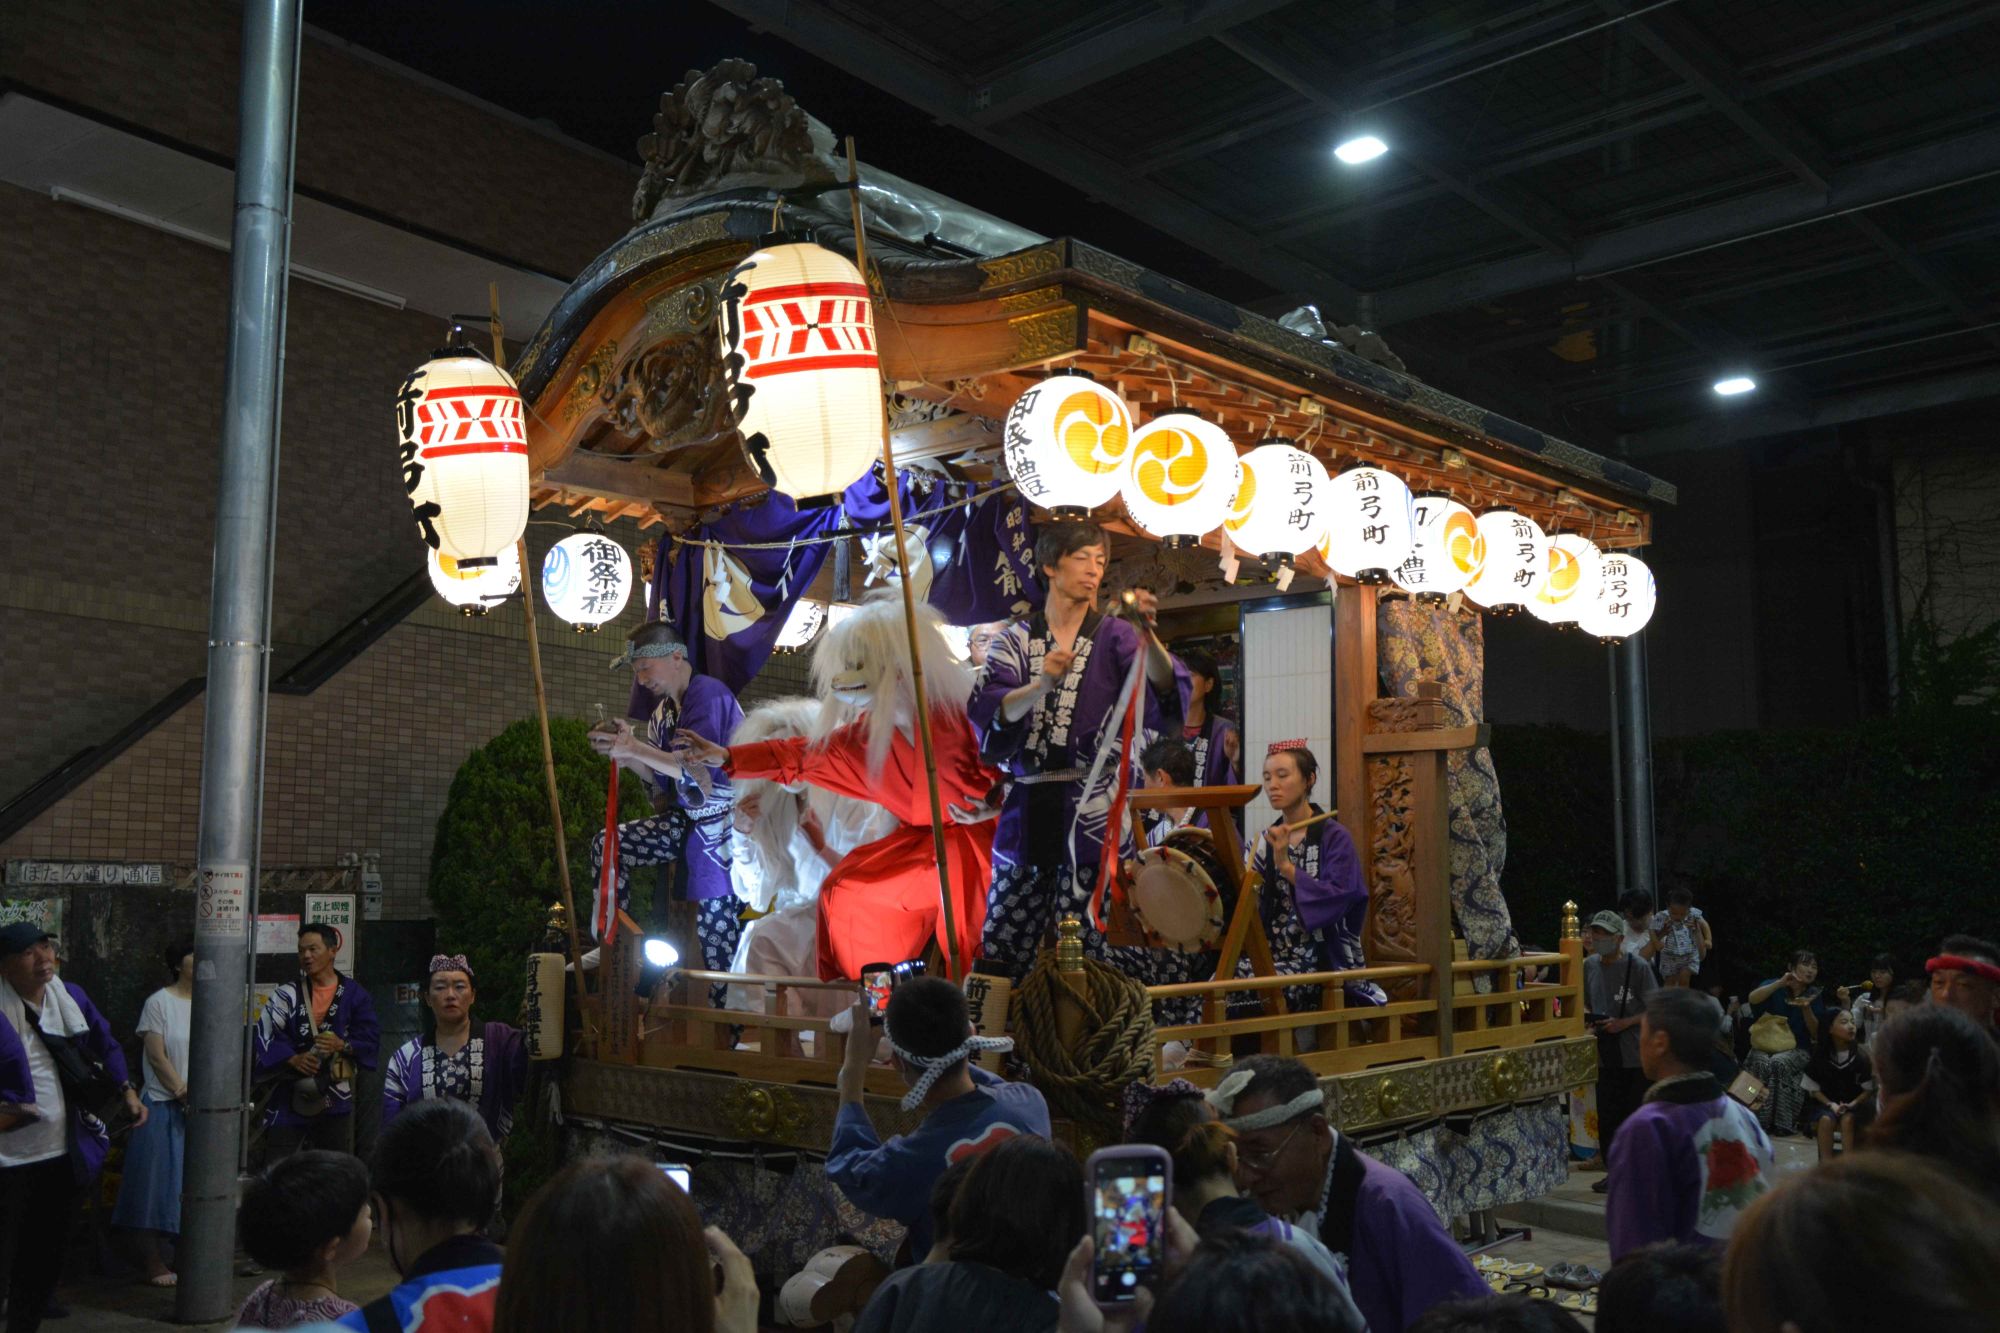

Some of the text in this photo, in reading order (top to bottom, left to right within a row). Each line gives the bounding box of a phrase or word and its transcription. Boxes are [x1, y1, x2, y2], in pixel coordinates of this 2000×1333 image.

[1288, 453, 1315, 531] 箭弓町
[1352, 472, 1390, 545] 箭弓町
[581, 539, 622, 614] 御祭禮
[1511, 519, 1536, 588] 箭弓町
[1607, 560, 1632, 618] 箭弓町
[23, 864, 161, 883] ぼたん通り通信
[312, 901, 350, 911] 路上喫煙
